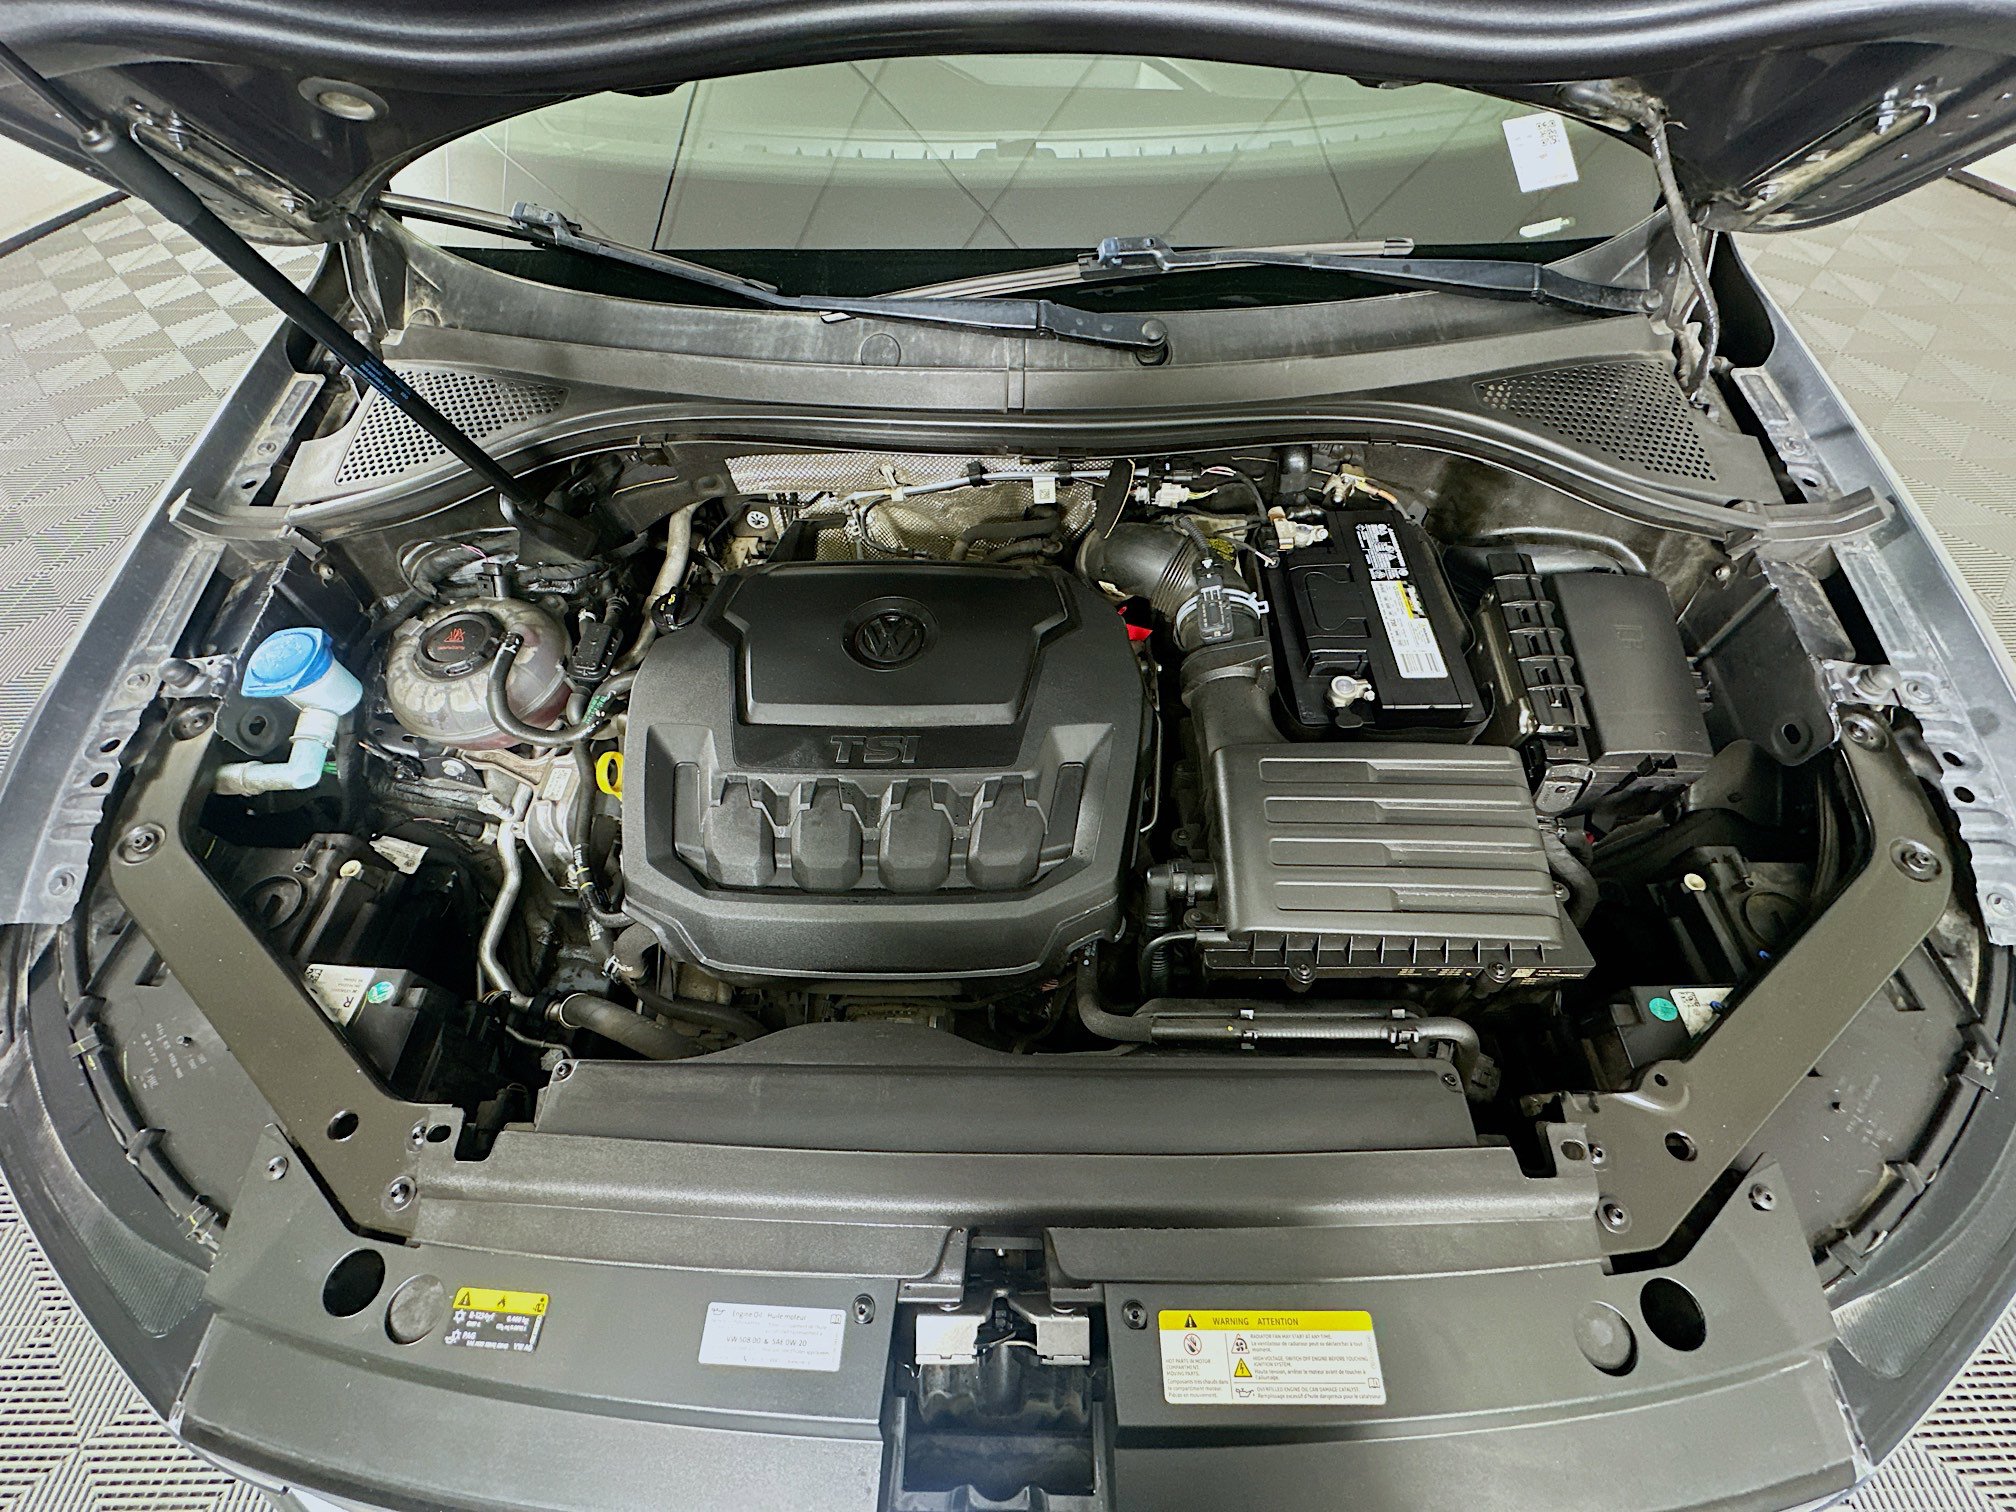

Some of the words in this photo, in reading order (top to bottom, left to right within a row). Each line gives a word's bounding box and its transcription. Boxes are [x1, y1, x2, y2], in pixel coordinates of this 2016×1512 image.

[830, 735, 922, 764] TSI
[732, 1310, 752, 1318] Engine
[1212, 1317, 1249, 1326] WARNING
[1258, 1317, 1298, 1326] ATTENTION
